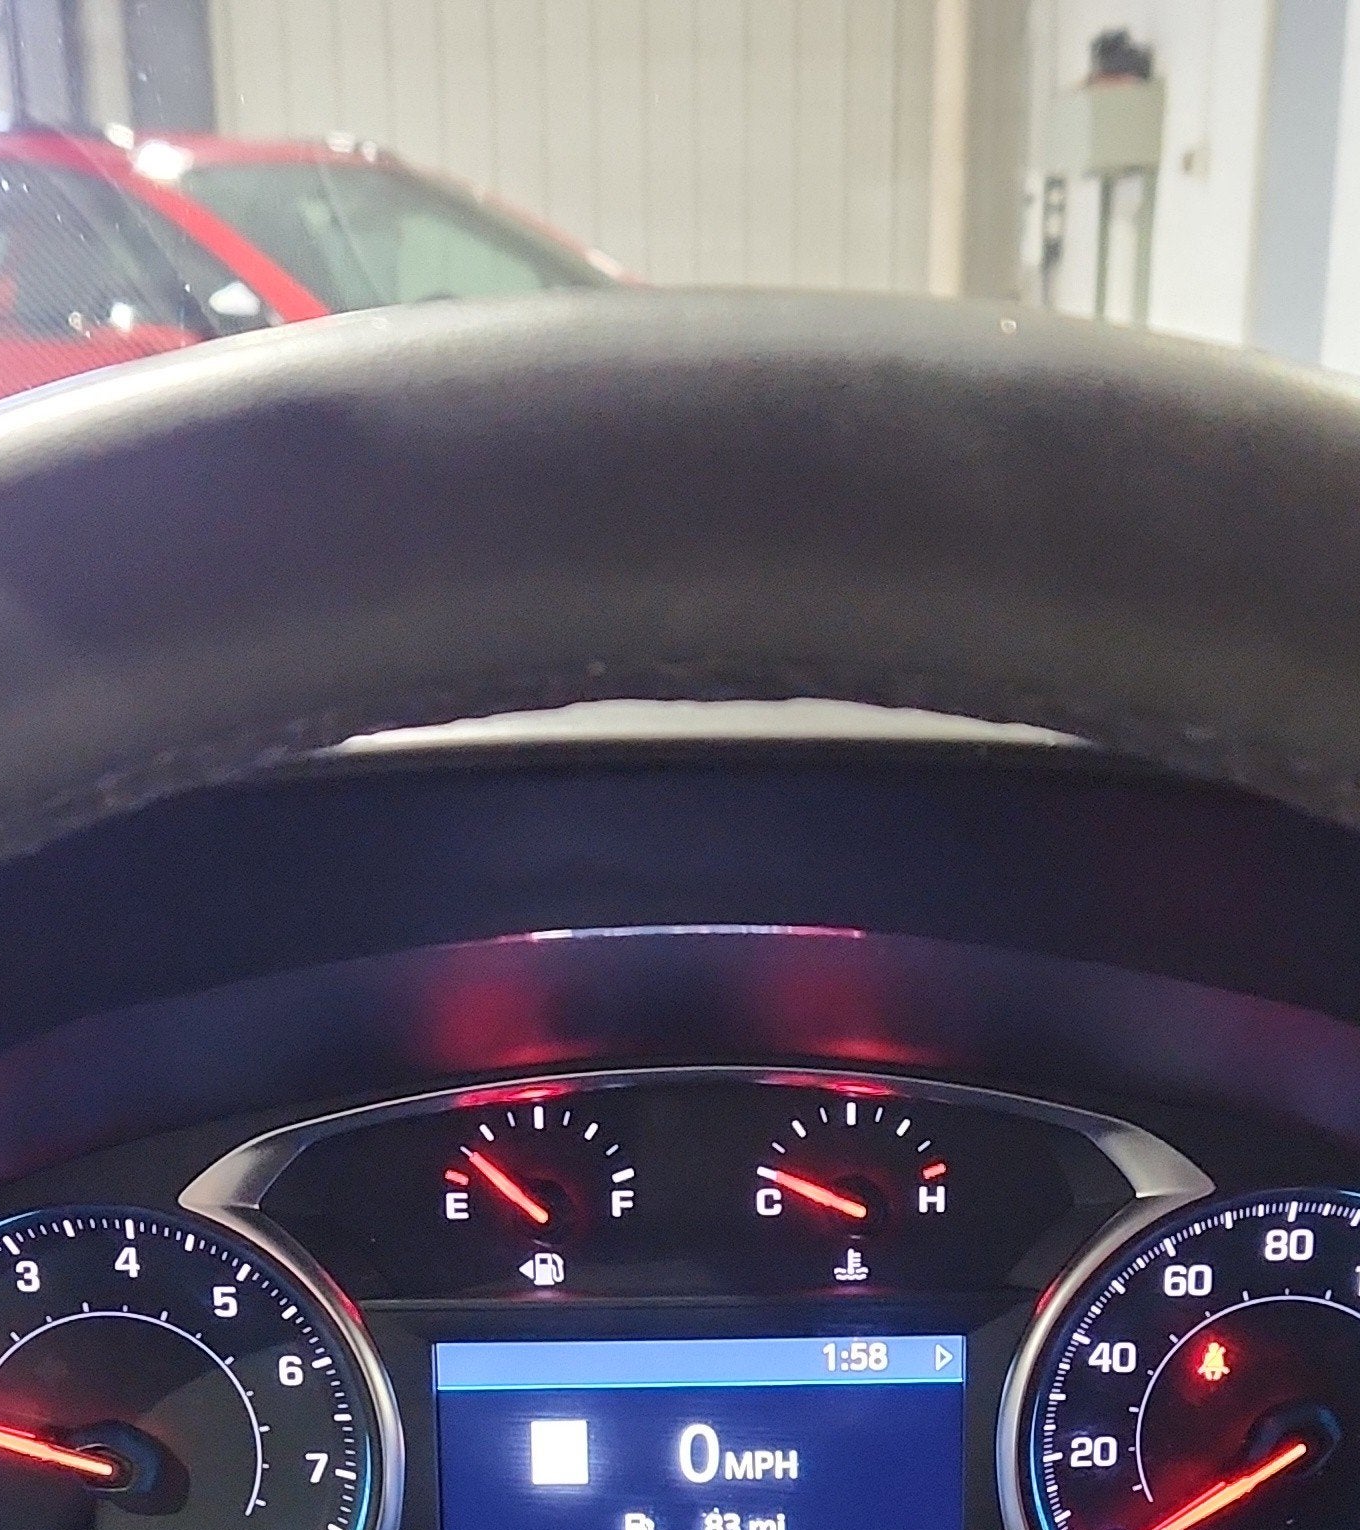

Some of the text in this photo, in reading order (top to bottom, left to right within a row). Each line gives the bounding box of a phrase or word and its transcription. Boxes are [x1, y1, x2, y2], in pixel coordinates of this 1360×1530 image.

[445, 1192, 470, 1221] E
[611, 1190, 635, 1218] F
[756, 1188, 783, 1217] C
[918, 1185, 946, 1213] H
[1264, 1228, 1314, 1261] 80
[15, 1260, 41, 1293] 3
[114, 1246, 141, 1278] 4
[1163, 1264, 1213, 1297] 60
[212, 1286, 238, 1318] 5
[278, 1355, 304, 1387] 6
[822, 1342, 889, 1372] 1:58
[1088, 1341, 1137, 1373] 40
[305, 1452, 329, 1484] 7
[677, 1422, 799, 1484] 0 MPH
[1070, 1436, 1121, 1468] 20
